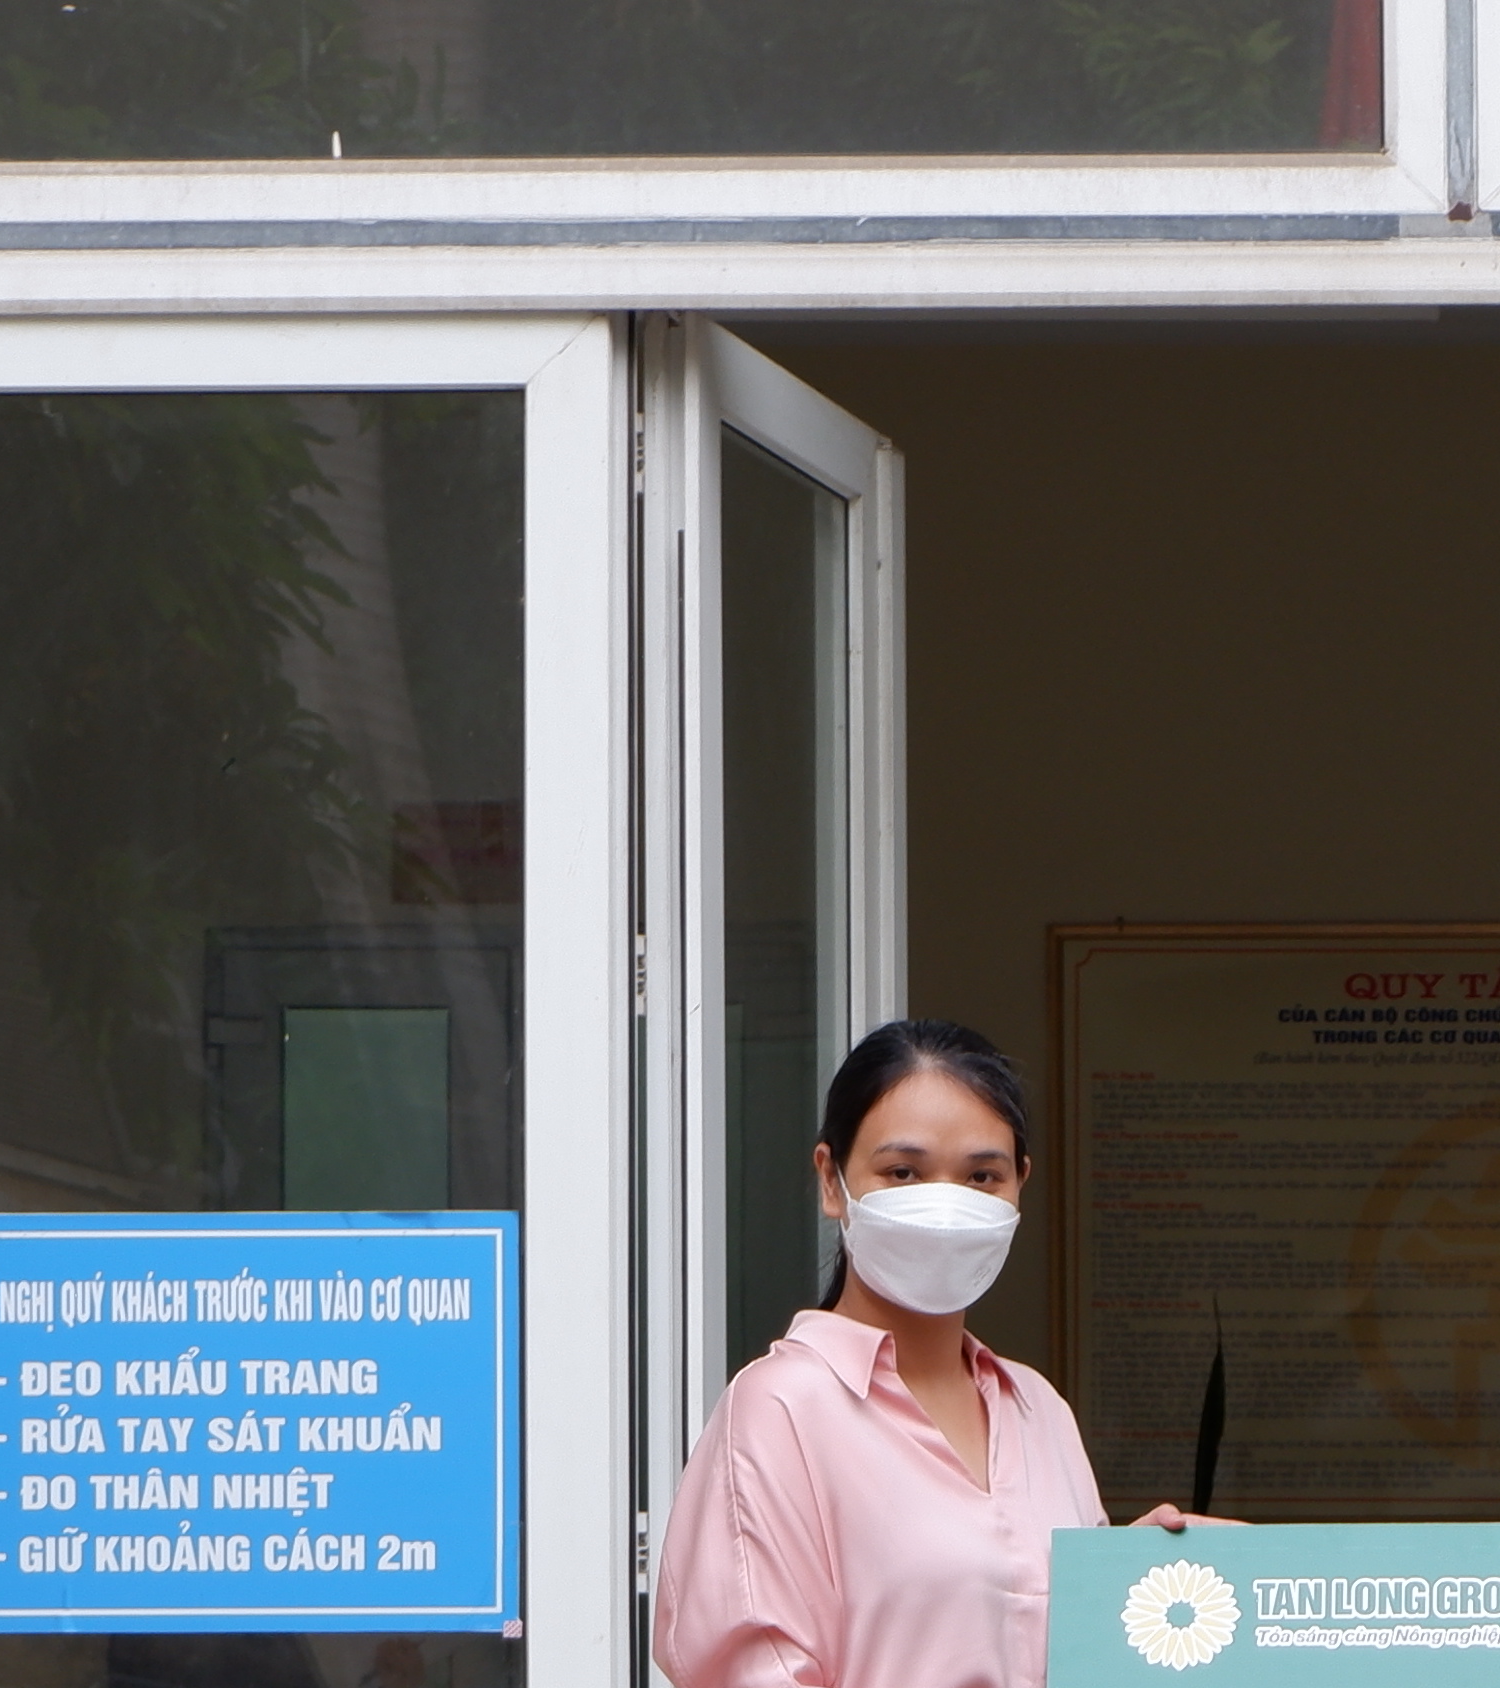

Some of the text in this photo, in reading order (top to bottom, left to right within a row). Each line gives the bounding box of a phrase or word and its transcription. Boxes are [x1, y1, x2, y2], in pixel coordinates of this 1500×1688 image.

[1345, 971, 1443, 1001] QUY
[0, 1279, 55, 1333] NGHỊ
[61, 1271, 104, 1328] QUÝ
[112, 1271, 188, 1323] KHÁCH
[194, 1268, 268, 1323] TRƯỚC
[275, 1279, 313, 1322] KHI
[320, 1270, 362, 1322] VÀO
[370, 1276, 402, 1322] CƠ
[408, 1278, 471, 1326] QUAN
[20, 1346, 378, 1397] ĐEO KHẨU TRANG
[22, 1402, 442, 1454] RỬA TAY SÁT KHUẨN
[20, 1467, 334, 1516] ĐO THÂN NHIỆT
[18, 1520, 436, 1573] GIỮ KHOẢNG CÁCH 2m
[1254, 1579, 1328, 1619] TAN
[1331, 1578, 1430, 1619] LONG
[1296, 1628, 1342, 1648] sáng
[1344, 1628, 1391, 1648] cùng
[1394, 1628, 1444, 1647] Nông
